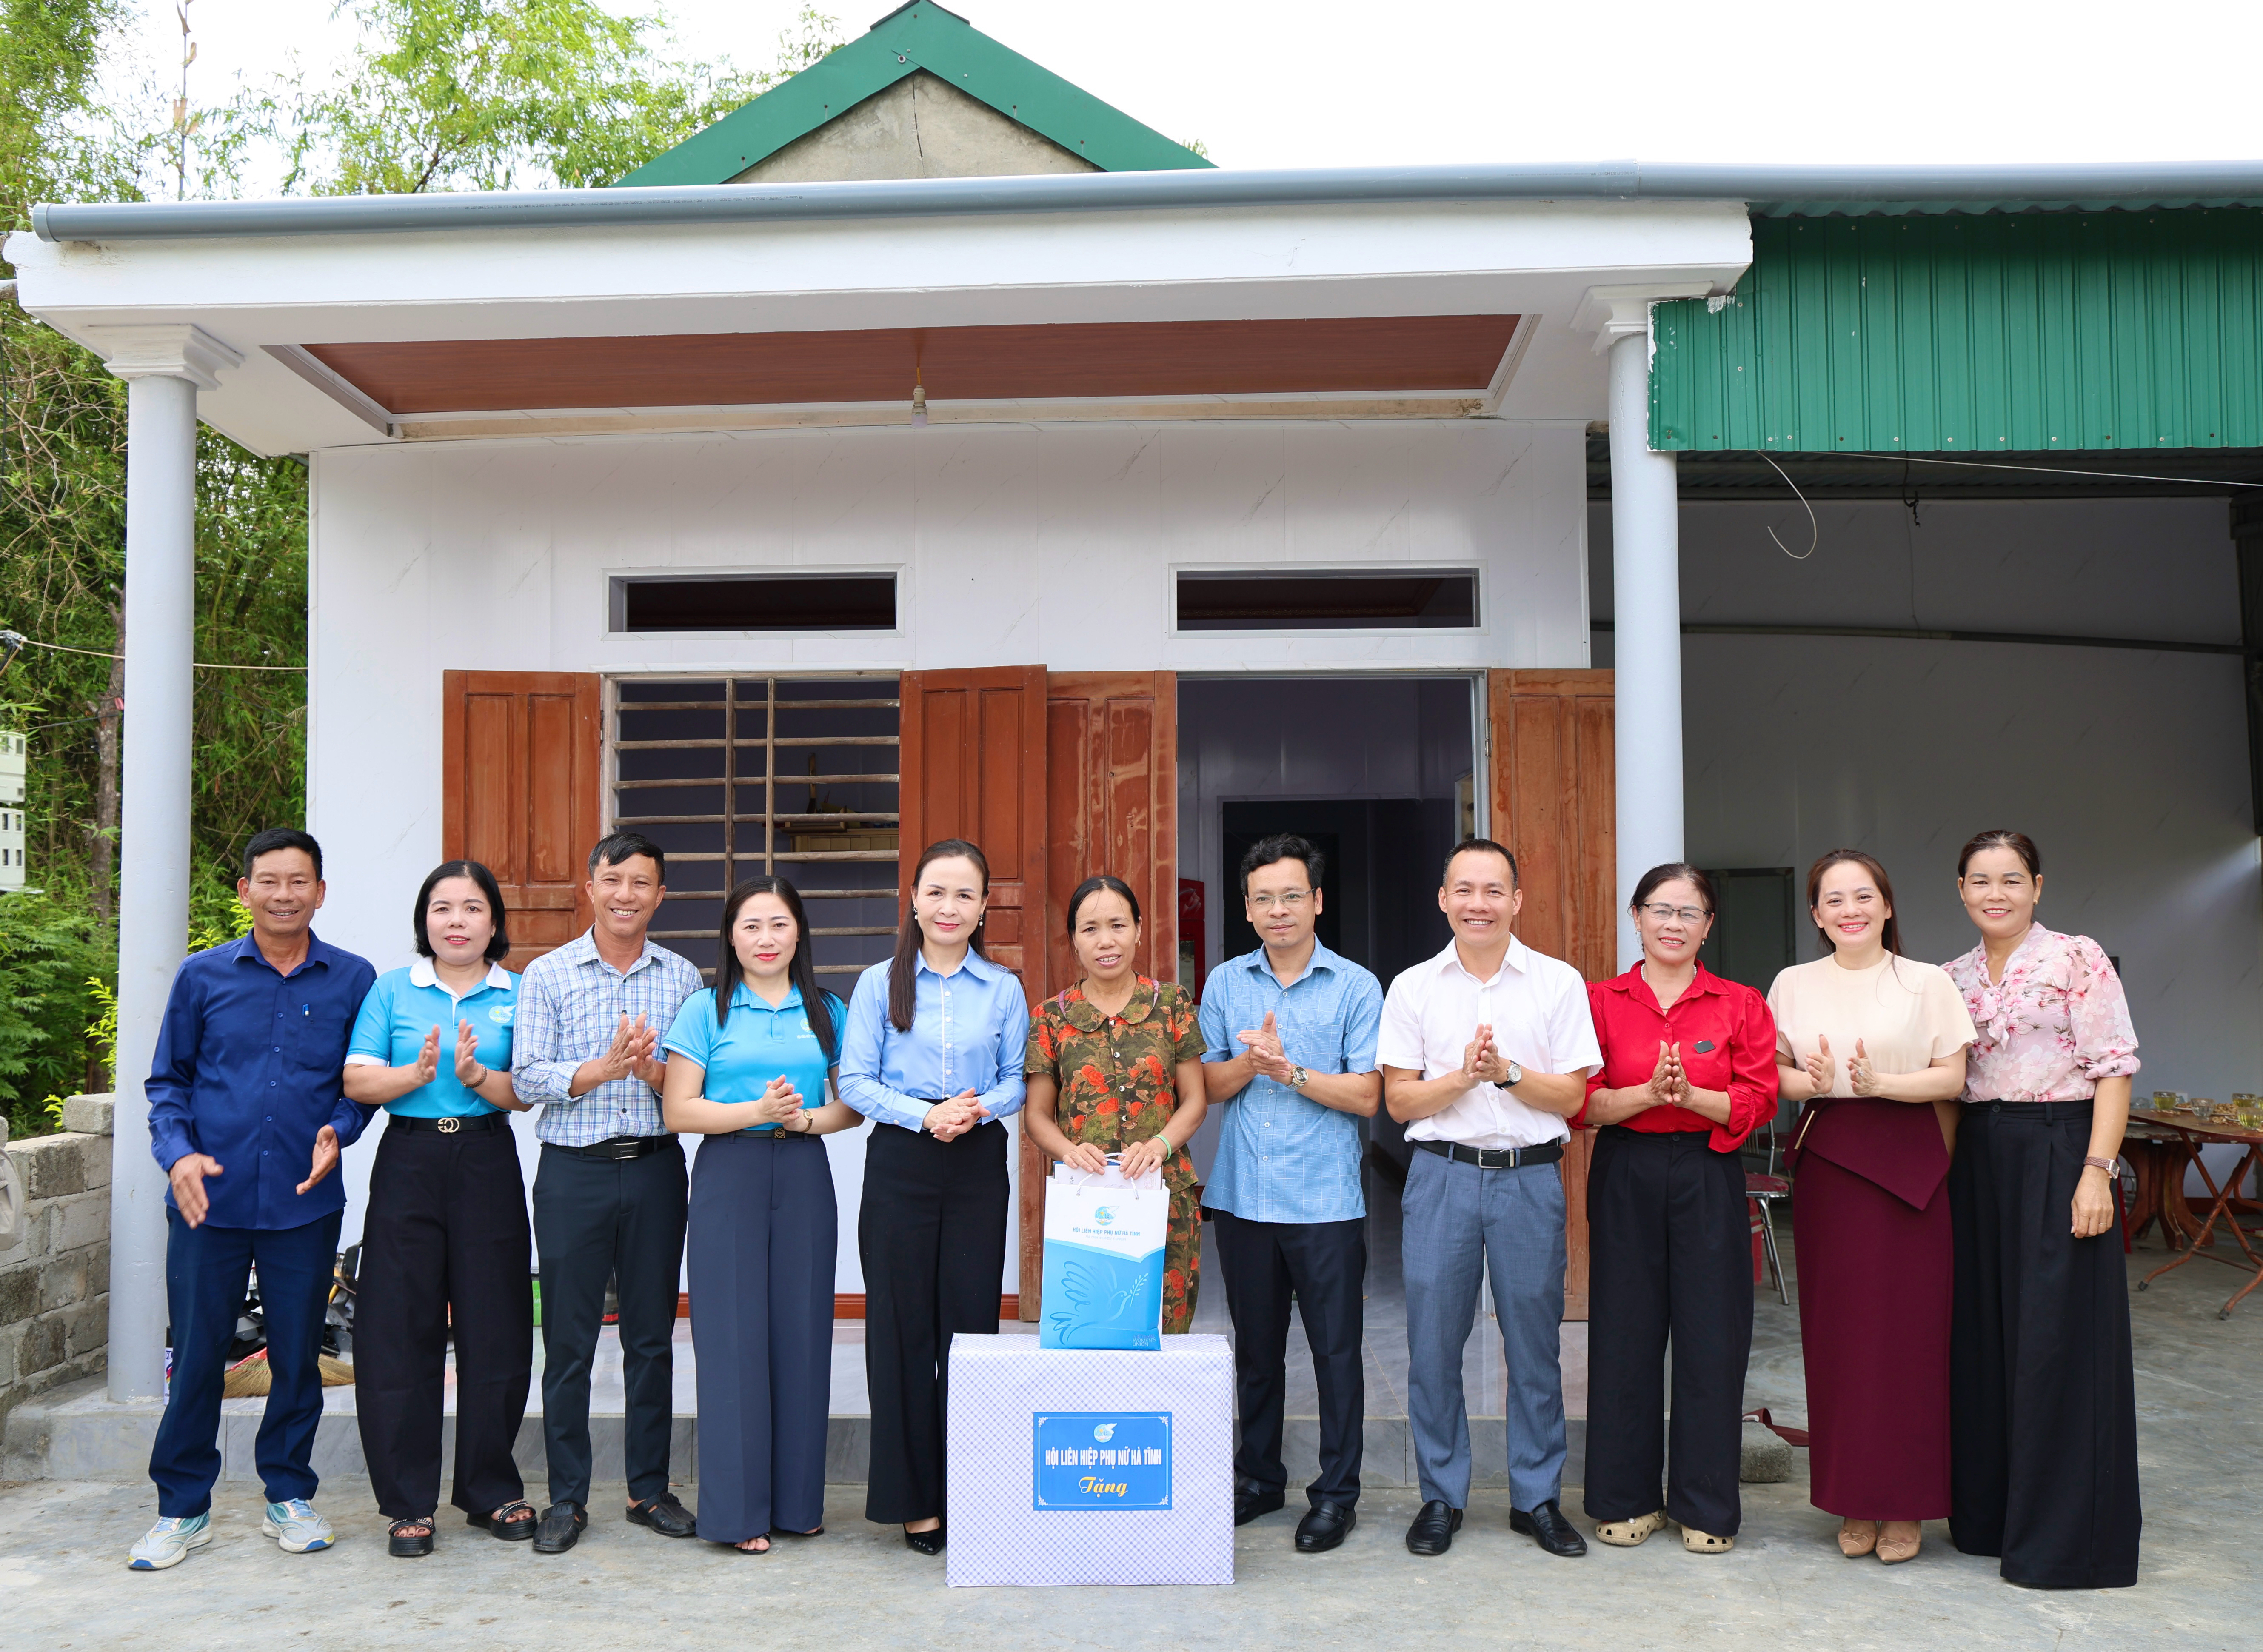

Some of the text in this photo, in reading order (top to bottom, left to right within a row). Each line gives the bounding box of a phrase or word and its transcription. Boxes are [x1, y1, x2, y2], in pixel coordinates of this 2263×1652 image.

[1045, 1446, 1161, 1469] HỘI LIÊN HIỆP PHỤ NỮ HÀ TĨNH
[1079, 1476, 1129, 1498] Tặng
